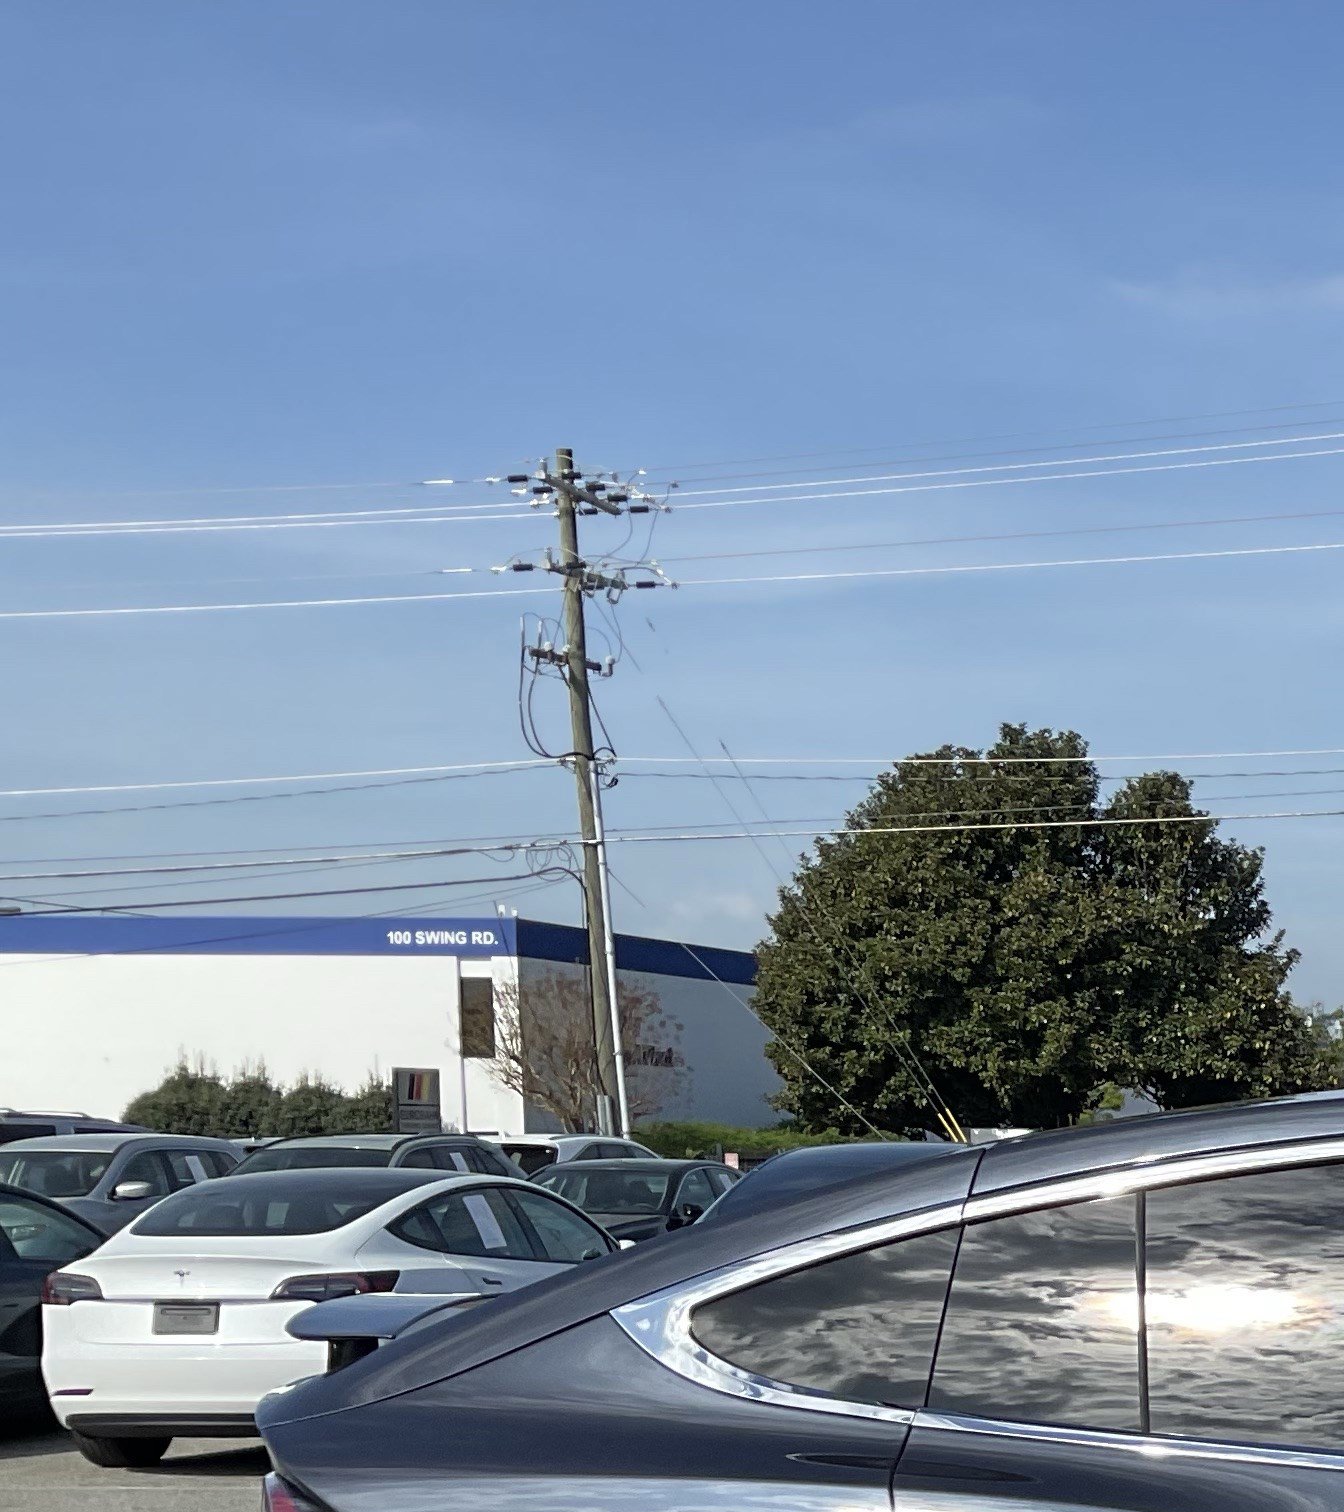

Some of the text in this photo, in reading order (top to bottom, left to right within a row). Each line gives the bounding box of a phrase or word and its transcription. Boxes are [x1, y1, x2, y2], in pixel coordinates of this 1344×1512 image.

[387, 931, 499, 946] 100 SWING RD.
